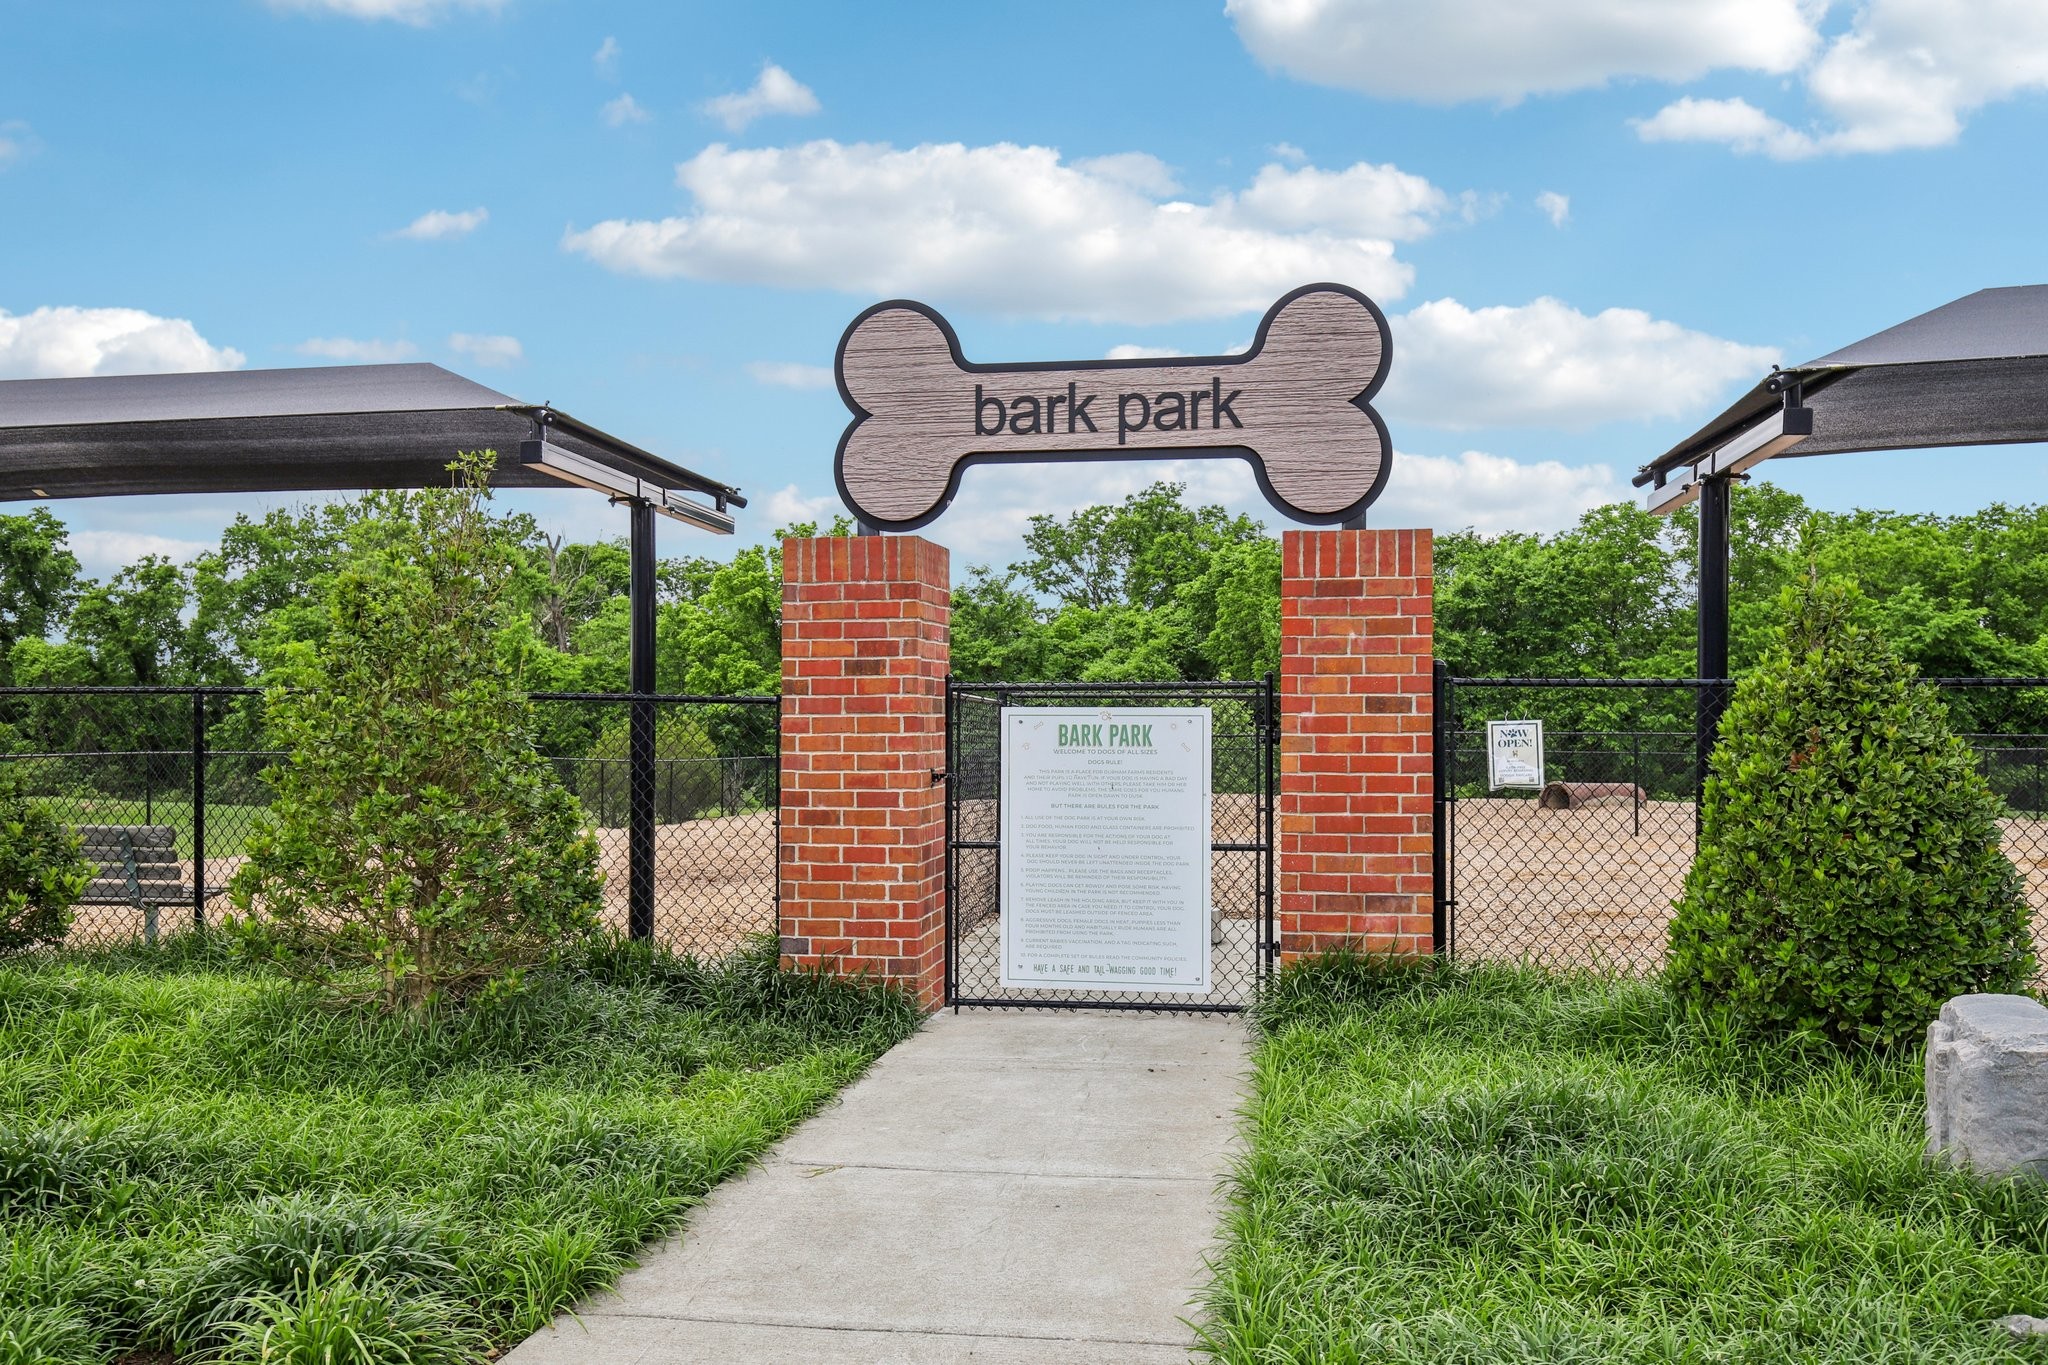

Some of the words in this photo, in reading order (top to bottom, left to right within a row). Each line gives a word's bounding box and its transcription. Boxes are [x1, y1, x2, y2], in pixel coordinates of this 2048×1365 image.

[974, 381, 1098, 436] bark
[1117, 377, 1244, 445] park
[1058, 724, 1103, 747] BARK
[1109, 724, 1153, 747] PARK
[1498, 739, 1532, 748] OPEN!
[1033, 964, 1048, 974] HAVE
[1052, 964, 1056, 972] A
[1059, 964, 1074, 975] SAFE
[1078, 965, 1090, 973] AND
[1094, 963, 1136, 976] TAIL-WAGGING
[1140, 966, 1156, 975] GOOD
[1160, 967, 1177, 978] TIME!
